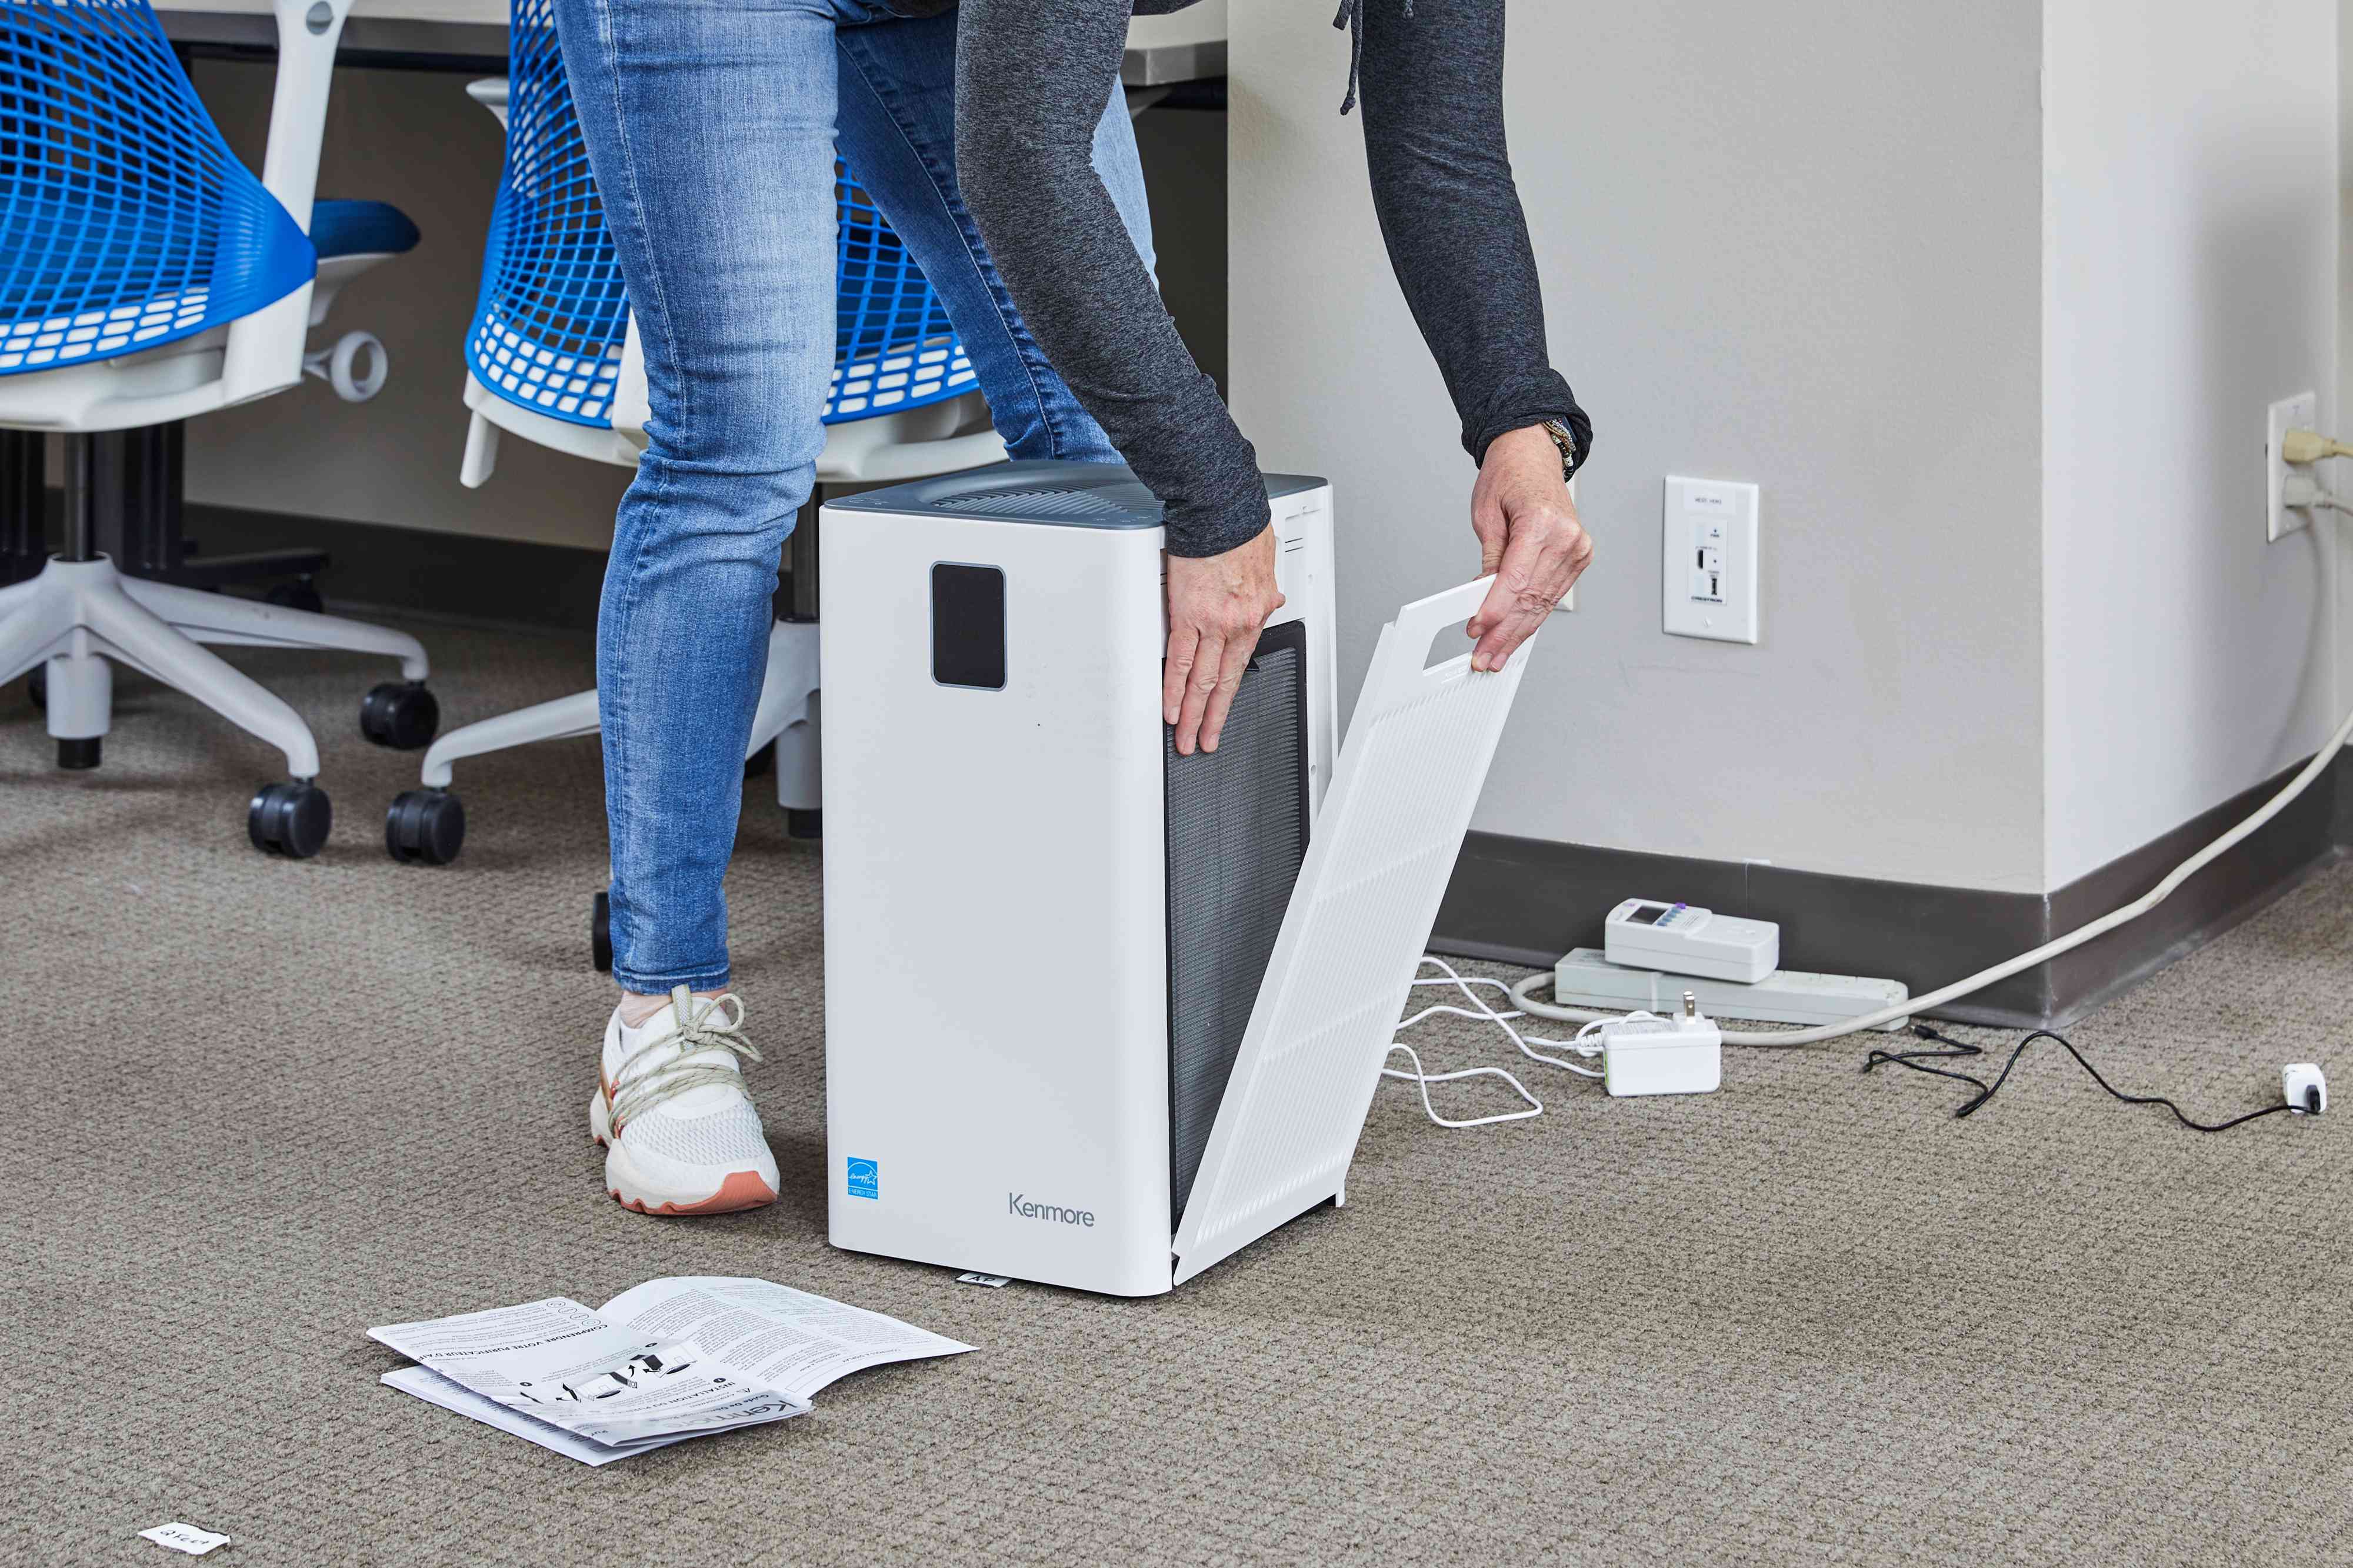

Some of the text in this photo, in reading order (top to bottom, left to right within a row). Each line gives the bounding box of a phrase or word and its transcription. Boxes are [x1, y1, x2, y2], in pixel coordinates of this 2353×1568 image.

[849, 1187, 866, 1196] ENERGY
[1009, 1192, 1095, 1227] Kenmore
[545, 1324, 608, 1343] COMPRENDRE
[445, 1346, 511, 1356] PURIFICATEUR
[511, 1341, 544, 1350] VOTRE
[669, 1382, 735, 1403] INSTALLATION
[743, 1394, 769, 1403] Guide
[664, 1400, 798, 1427] Kenmore
